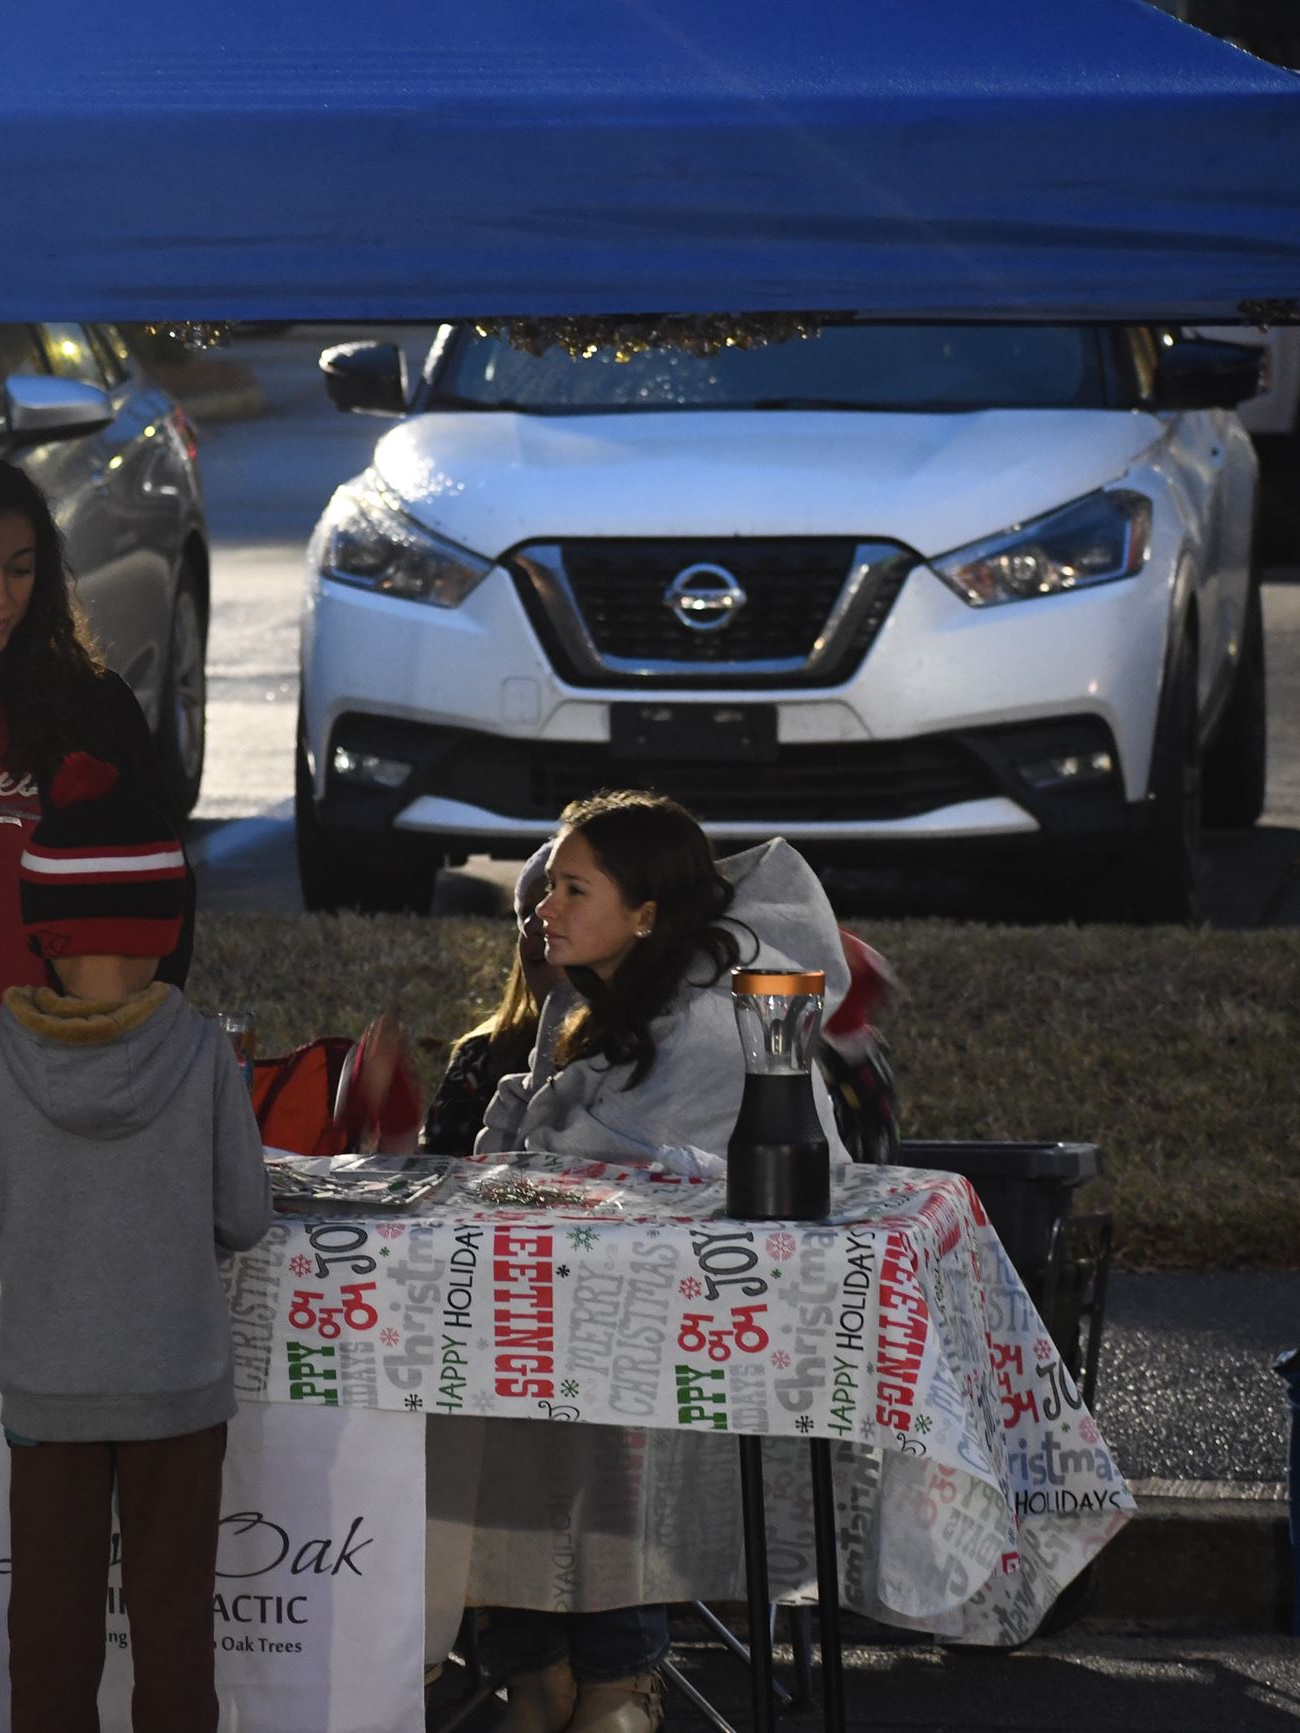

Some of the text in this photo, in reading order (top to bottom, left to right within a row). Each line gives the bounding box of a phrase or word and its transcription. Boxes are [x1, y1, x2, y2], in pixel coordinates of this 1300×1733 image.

[304, 1223, 378, 1279] JO
[443, 1224, 483, 1328] HOLIDAY
[690, 1230, 769, 1301] JOY
[493, 1225, 555, 1399] EETINGS
[566, 1260, 624, 1378] MERRY
[609, 1240, 680, 1417] CHRISTMAS
[286, 1341, 339, 1407] PPY
[675, 1364, 728, 1431] PPY
[215, 1511, 374, 1578] Oak
[211, 1594, 308, 1625] ACTIC
[221, 1637, 254, 1653] Oak
[258, 1637, 303, 1654] Trees
